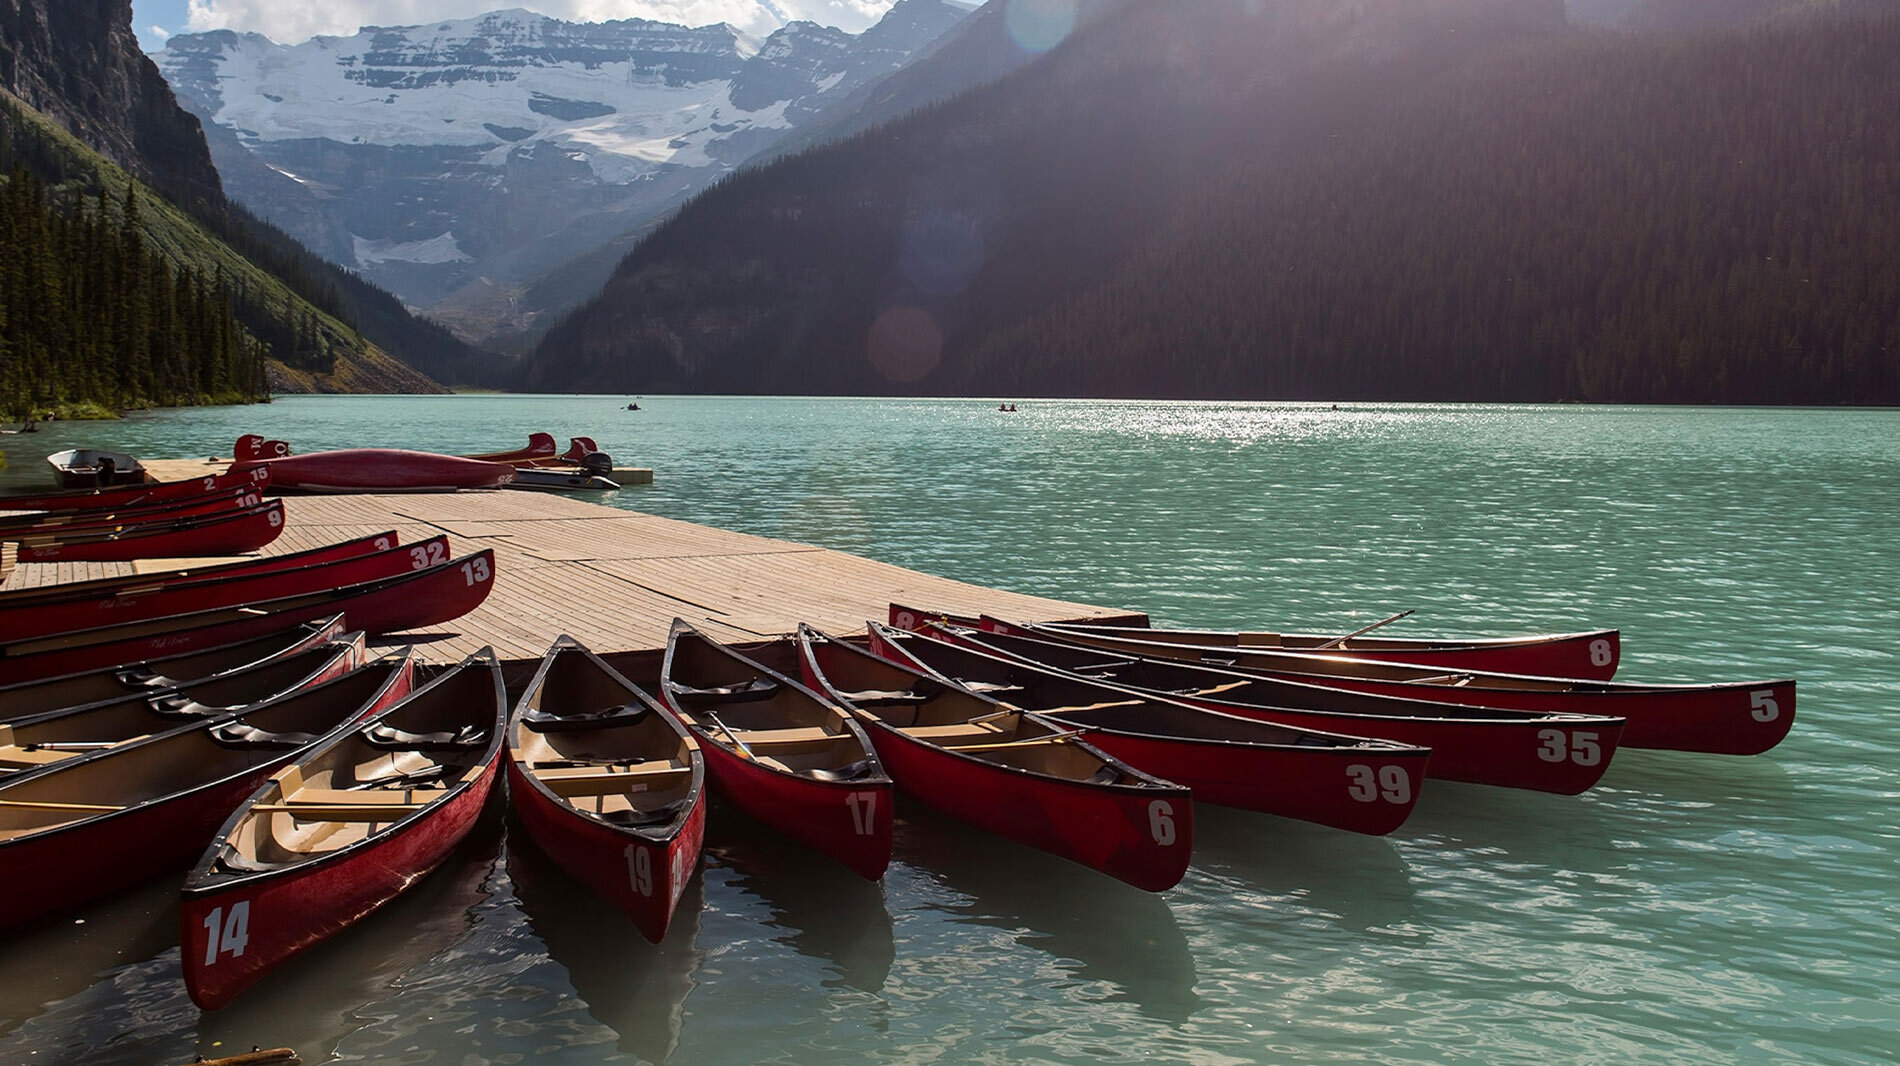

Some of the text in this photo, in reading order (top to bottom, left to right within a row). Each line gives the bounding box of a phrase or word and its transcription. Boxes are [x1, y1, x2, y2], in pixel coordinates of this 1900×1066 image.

[203, 477, 216, 491] 2
[250, 466, 269, 482] 15
[267, 509, 282, 528] 9
[410, 541, 447, 570] 32
[461, 556, 490, 587] 13
[1589, 639, 1612, 667] 8
[1750, 689, 1780, 723] 5
[1537, 728, 1601, 767] 35
[1345, 764, 1411, 804] 39
[845, 791, 877, 836] 17
[1148, 799, 1176, 846] 6
[624, 843, 653, 897] 19
[203, 899, 250, 967] 14
